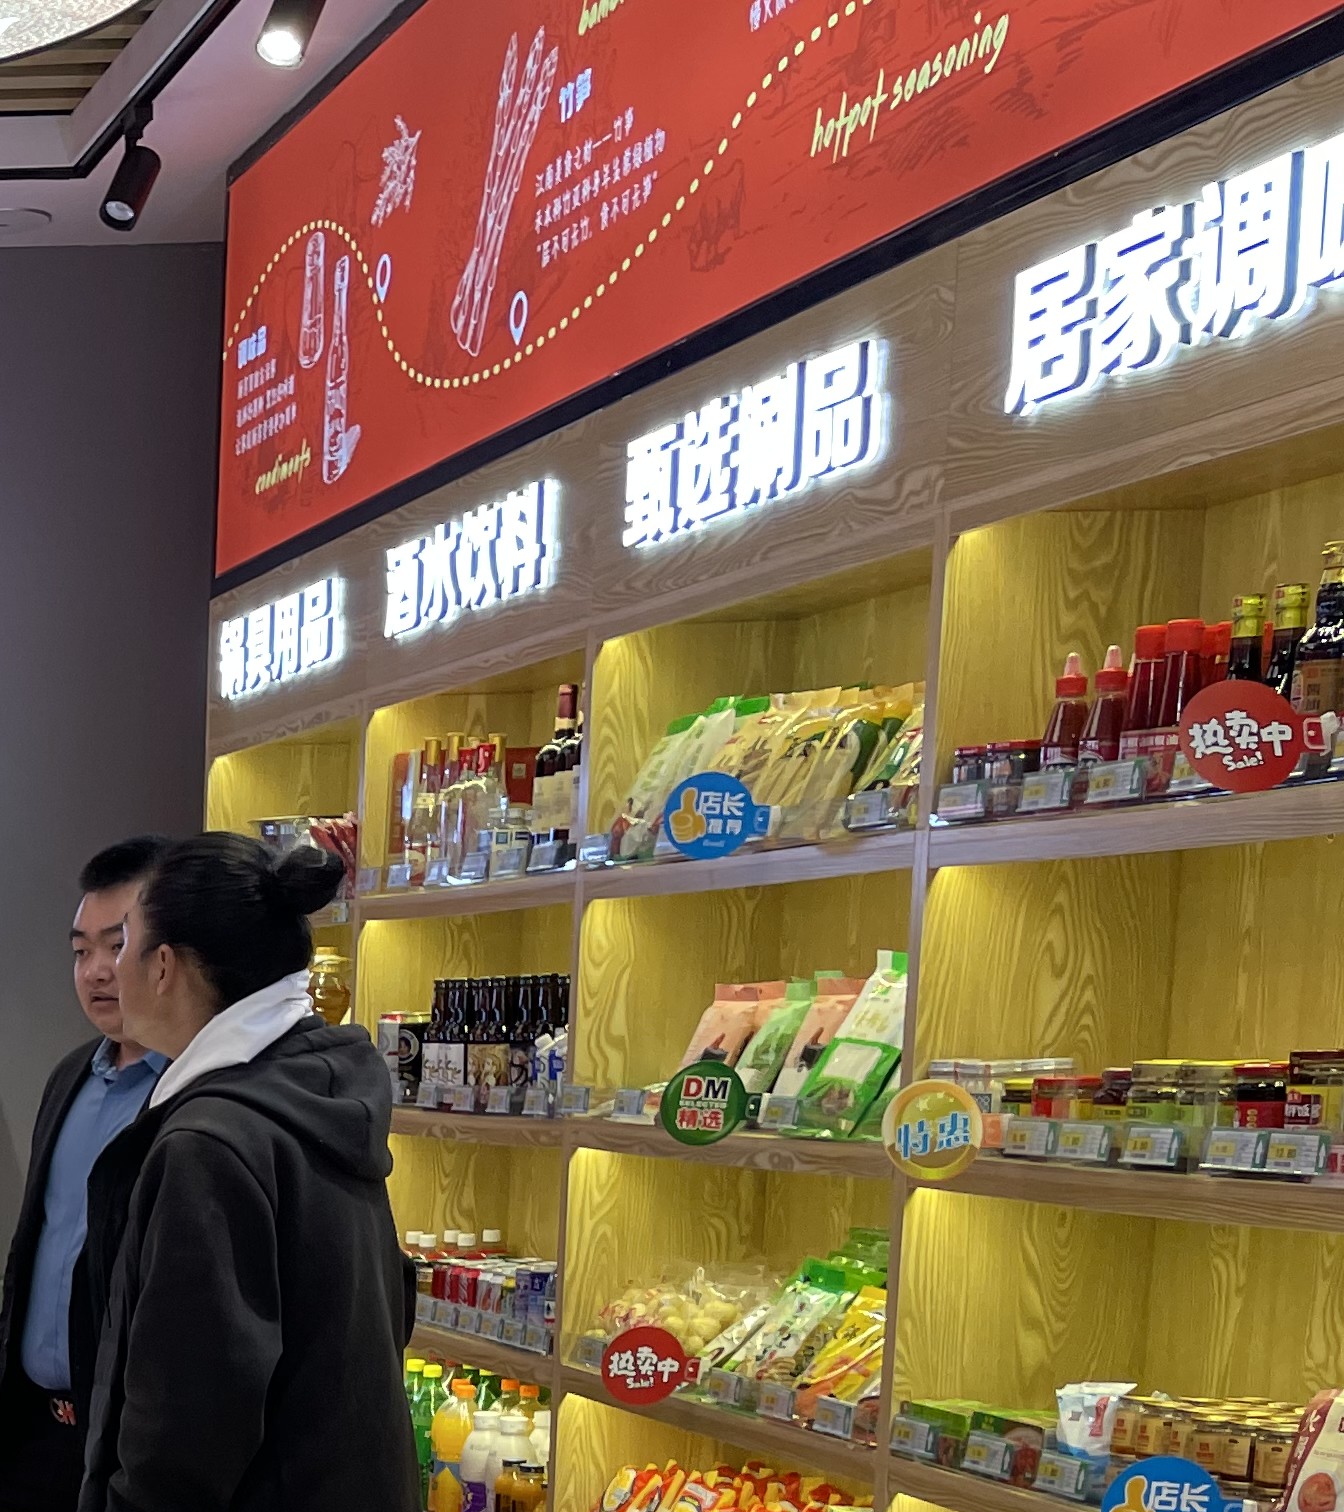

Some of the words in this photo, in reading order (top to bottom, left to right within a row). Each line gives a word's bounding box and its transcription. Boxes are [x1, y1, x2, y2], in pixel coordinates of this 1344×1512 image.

[383, 479, 560, 641] 酒水饮料
[1188, 710, 1293, 758] 热卖中
[1222, 752, 1265, 772] Sale!
[698, 791, 745, 816] 店长
[681, 1075, 731, 1100] DM
[675, 1107, 724, 1131] 精选
[896, 1111, 971, 1160] 特惠
[608, 1346, 680, 1380] 热卖中
